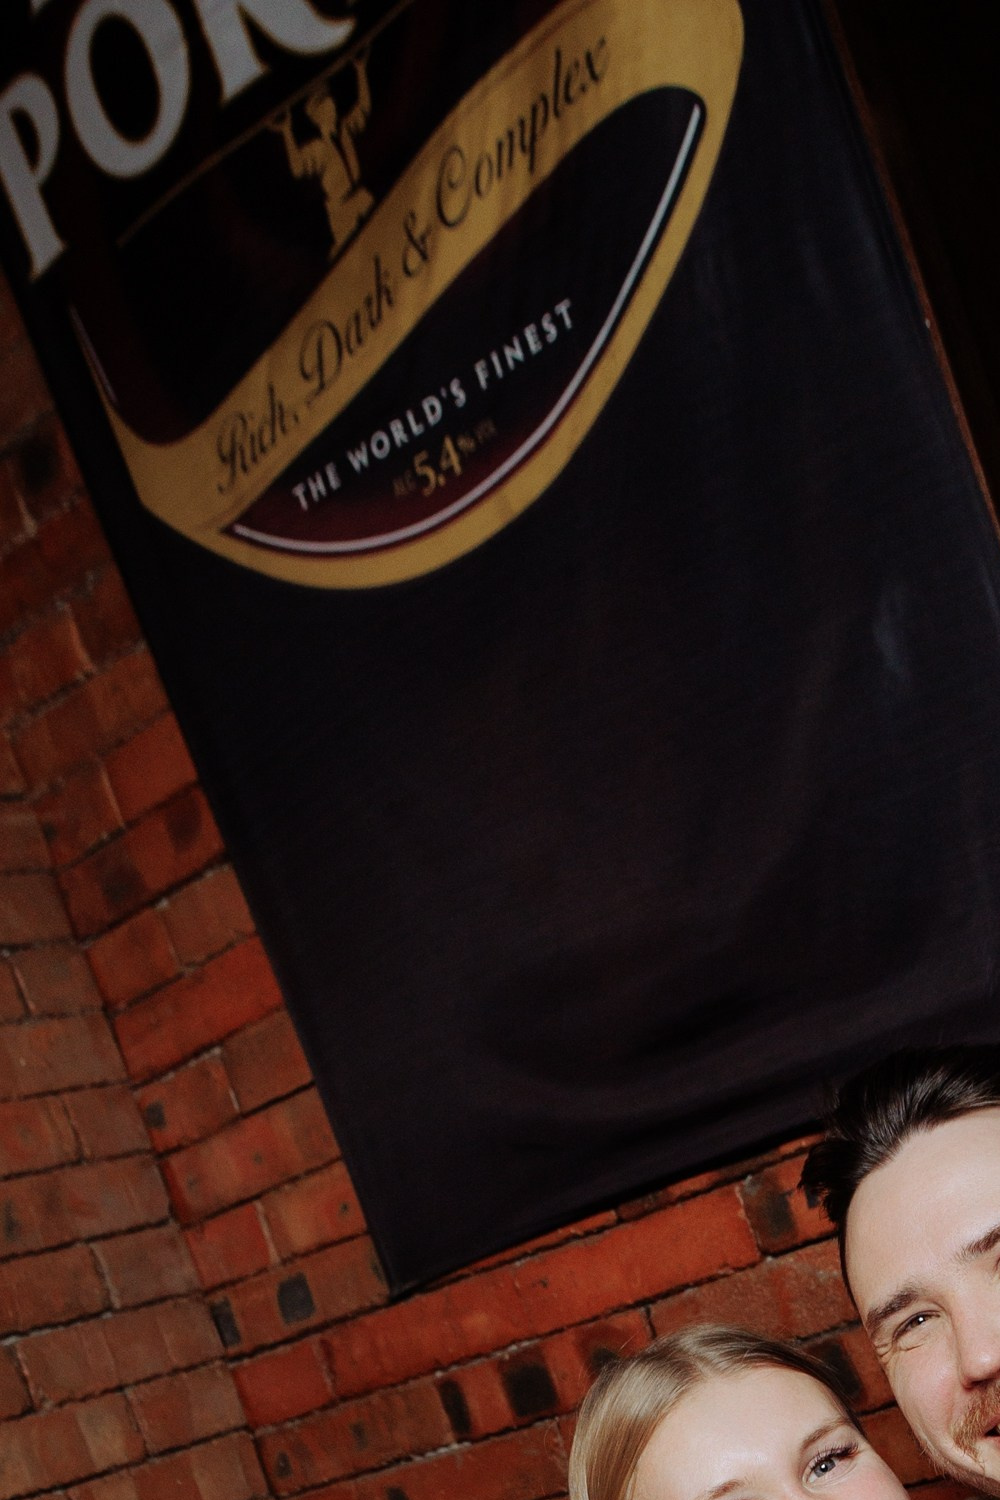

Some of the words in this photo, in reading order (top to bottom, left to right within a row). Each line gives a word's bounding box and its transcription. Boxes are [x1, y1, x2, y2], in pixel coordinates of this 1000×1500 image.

[215, 382, 299, 494] Rich,
[300, 262, 397, 410] Dark
[402, 215, 435, 281] &
[436, 36, 611, 230] Complex
[291, 461, 342, 511] THE
[346, 376, 467, 475] WORLD'S
[474, 298, 575, 391] FINEST
